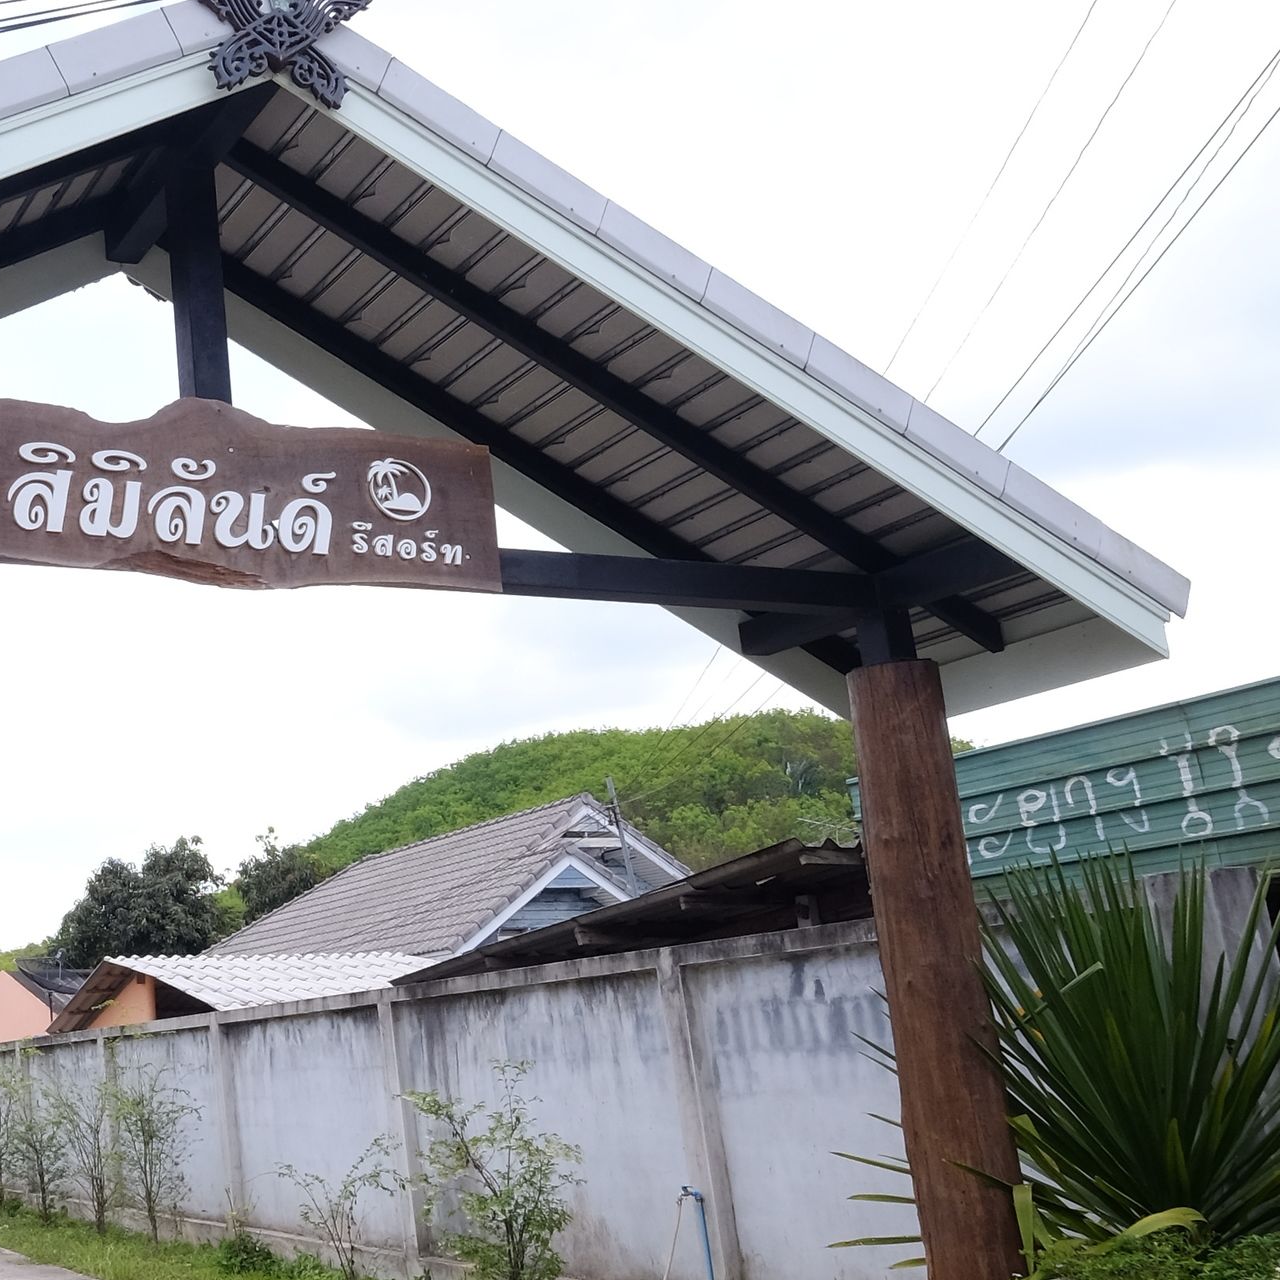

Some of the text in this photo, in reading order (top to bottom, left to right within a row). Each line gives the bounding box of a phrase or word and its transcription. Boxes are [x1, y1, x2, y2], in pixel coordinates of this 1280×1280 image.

[7, 442, 337, 555] สิมิลันด์
[351, 521, 463, 566] รีสอร์ท
